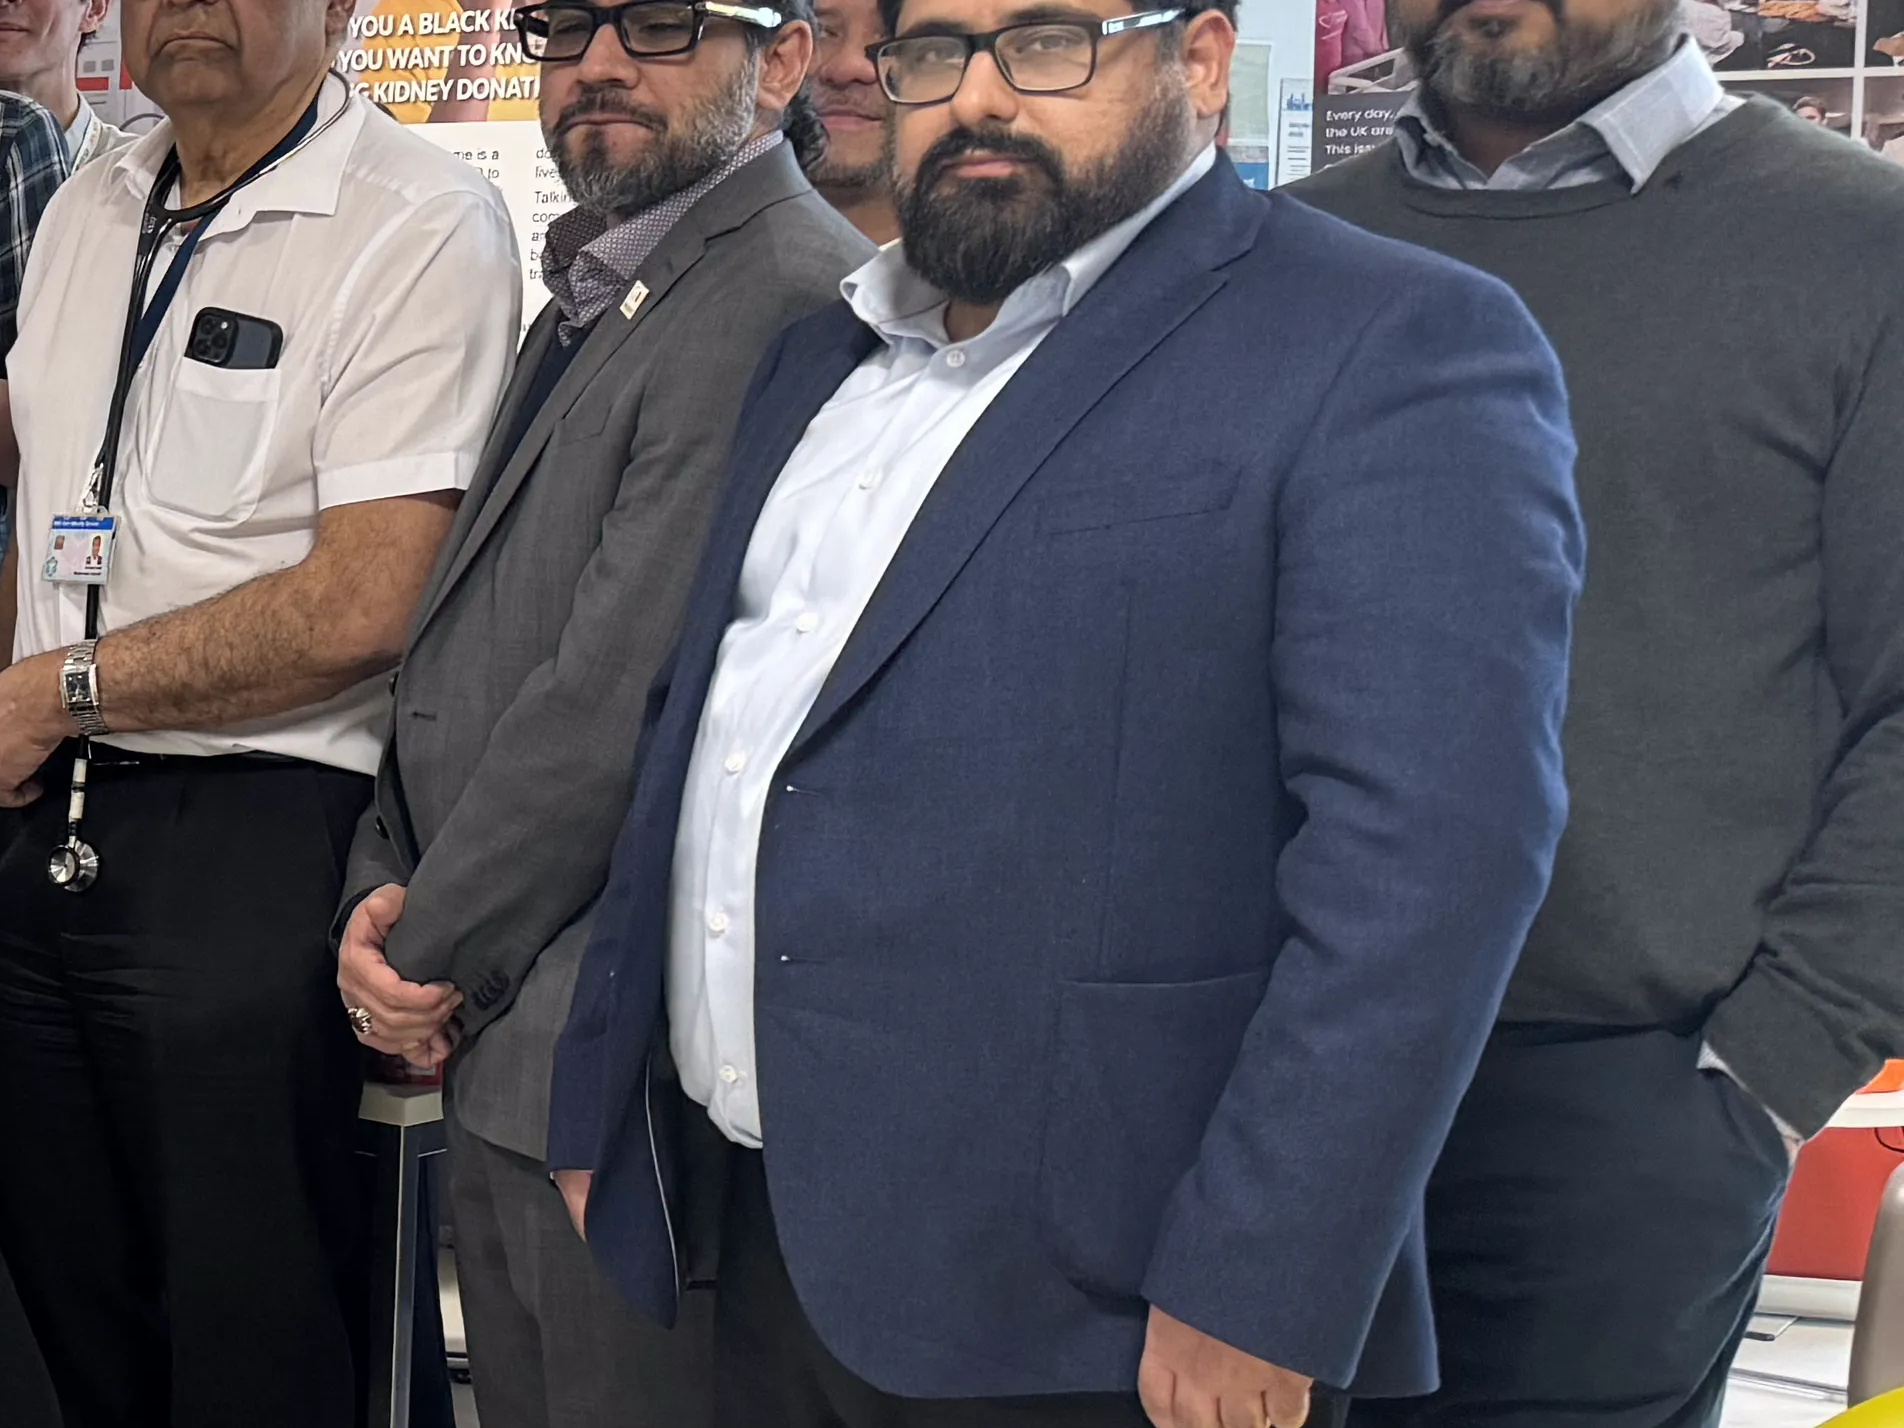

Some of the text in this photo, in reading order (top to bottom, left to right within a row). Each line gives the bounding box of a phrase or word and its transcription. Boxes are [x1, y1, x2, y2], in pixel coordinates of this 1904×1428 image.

[349, 13, 394, 39] YOU
[397, 14, 415, 36] A
[418, 8, 490, 35] BLACK
[339, 49, 384, 72] YOU
[385, 45, 455, 71] WANT
[457, 44, 488, 67] TO
[373, 78, 456, 104] KIDNEY
[457, 75, 541, 102] DONATI
[1325, 109, 1362, 123] Every
[1350, 126, 1369, 137] UK
[1325, 144, 1351, 155] This
[534, 190, 574, 205] Talkin
